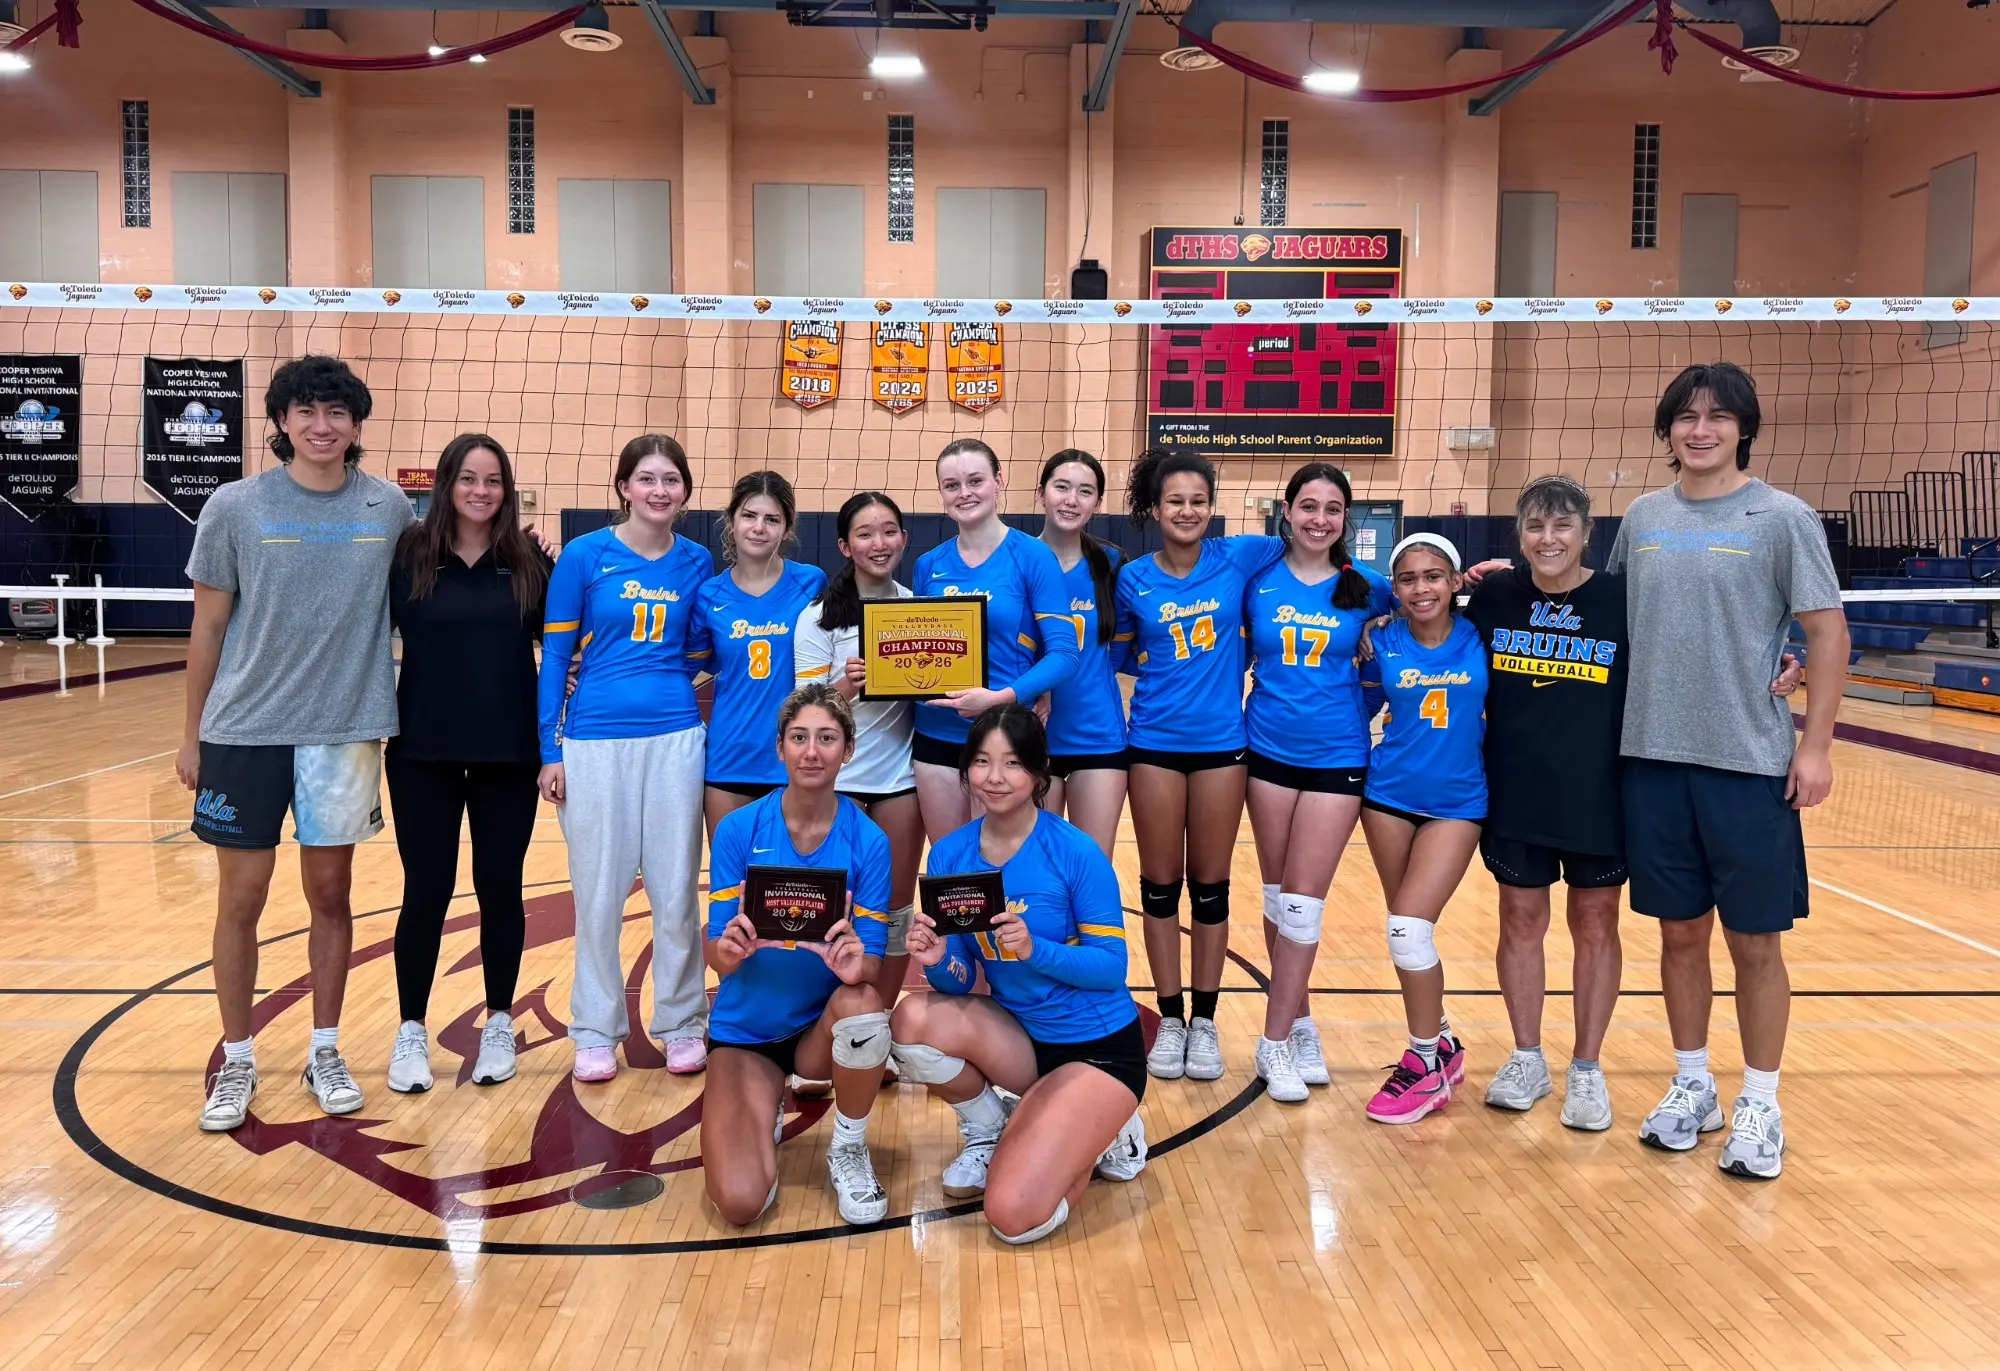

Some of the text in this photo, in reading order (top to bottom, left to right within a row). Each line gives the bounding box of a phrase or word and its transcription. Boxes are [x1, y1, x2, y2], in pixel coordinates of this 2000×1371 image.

[1166, 235, 1388, 260] dTHS JAGUARS
[60, 285, 102, 293] deToledo
[185, 287, 226, 295] deToledo
[309, 289, 351, 297] deToledo
[66, 292, 96, 301] Jaguars
[191, 294, 221, 303] Jaguars
[433, 291, 475, 299] deToledo
[558, 294, 599, 302] deToledo
[315, 296, 345, 305] Jaguars
[439, 298, 469, 307] Jaguars
[681, 296, 722, 304] deToledo
[803, 299, 843, 307] deToledo
[924, 300, 963, 308] deToledo
[1403, 300, 1443, 308] deToledo
[1525, 299, 1565, 307] deToledo
[1645, 299, 1684, 307] deToledo
[1764, 300, 1803, 308] deToledo
[1882, 299, 1922, 307] deToledo
[563, 301, 593, 310] Jaguars
[686, 303, 716, 312] Jaguars
[1044, 301, 1083, 309] deToledo
[1163, 301, 1203, 309] deToledo
[1283, 301, 1322, 309] deToledo
[808, 306, 838, 315] Jaguars
[928, 307, 958, 316] Jaguars
[1048, 308, 1077, 317] Jaguars
[1167, 308, 1197, 317] Jaguars
[1287, 308, 1317, 317] Jaguars
[1408, 307, 1438, 316] Jaguars
[1530, 306, 1558, 315] Jaguars
[1648, 306, 1678, 314] Jaguars
[1886, 306, 1915, 314] Jaguars
[790, 325, 838, 344] CHAMPION
[877, 330, 924, 347] CHAMPION
[951, 329, 997, 346] CHAMPION
[1259, 337, 1289, 350] period
[790, 376, 831, 392] 2018
[879, 382, 921, 395] 2024
[957, 380, 997, 394] 2025
[147, 389, 187, 397] NATIONAL
[1160, 435, 1382, 446] de Toledo High School Parent Organization
[193, 455, 241, 463] CHAMPIONS
[8, 474, 56, 482] deTOLEDO
[171, 475, 218, 484] deTOLEDO
[12, 486, 53, 494] JAGUARS
[174, 487, 215, 495] JAGUARS
[620, 580, 680, 601] Bruins
[1159, 598, 1220, 623] Bruins
[1273, 605, 1340, 628] Bruins
[1530, 601, 1581, 630] Ucla
[631, 603, 666, 643] 11
[729, 619, 789, 639] Bruins
[878, 630, 967, 640] INVITATIONAL
[1169, 615, 1217, 660] 14
[883, 641, 964, 653] CHAMPIONS
[1280, 627, 1330, 667] 17
[1492, 628, 1616, 666] BRUINS
[748, 640, 771, 679] 8
[895, 657, 952, 668] 20 26
[1500, 657, 1596, 679] VOLLEYBALL
[1396, 669, 1472, 689] Bruins
[1420, 689, 1449, 729] 4
[765, 890, 827, 900] INVITATIONAL
[938, 893, 986, 902] INVITATIONAL
[806, 900, 824, 909] PLAYER
[772, 908, 816, 918] 20 26
